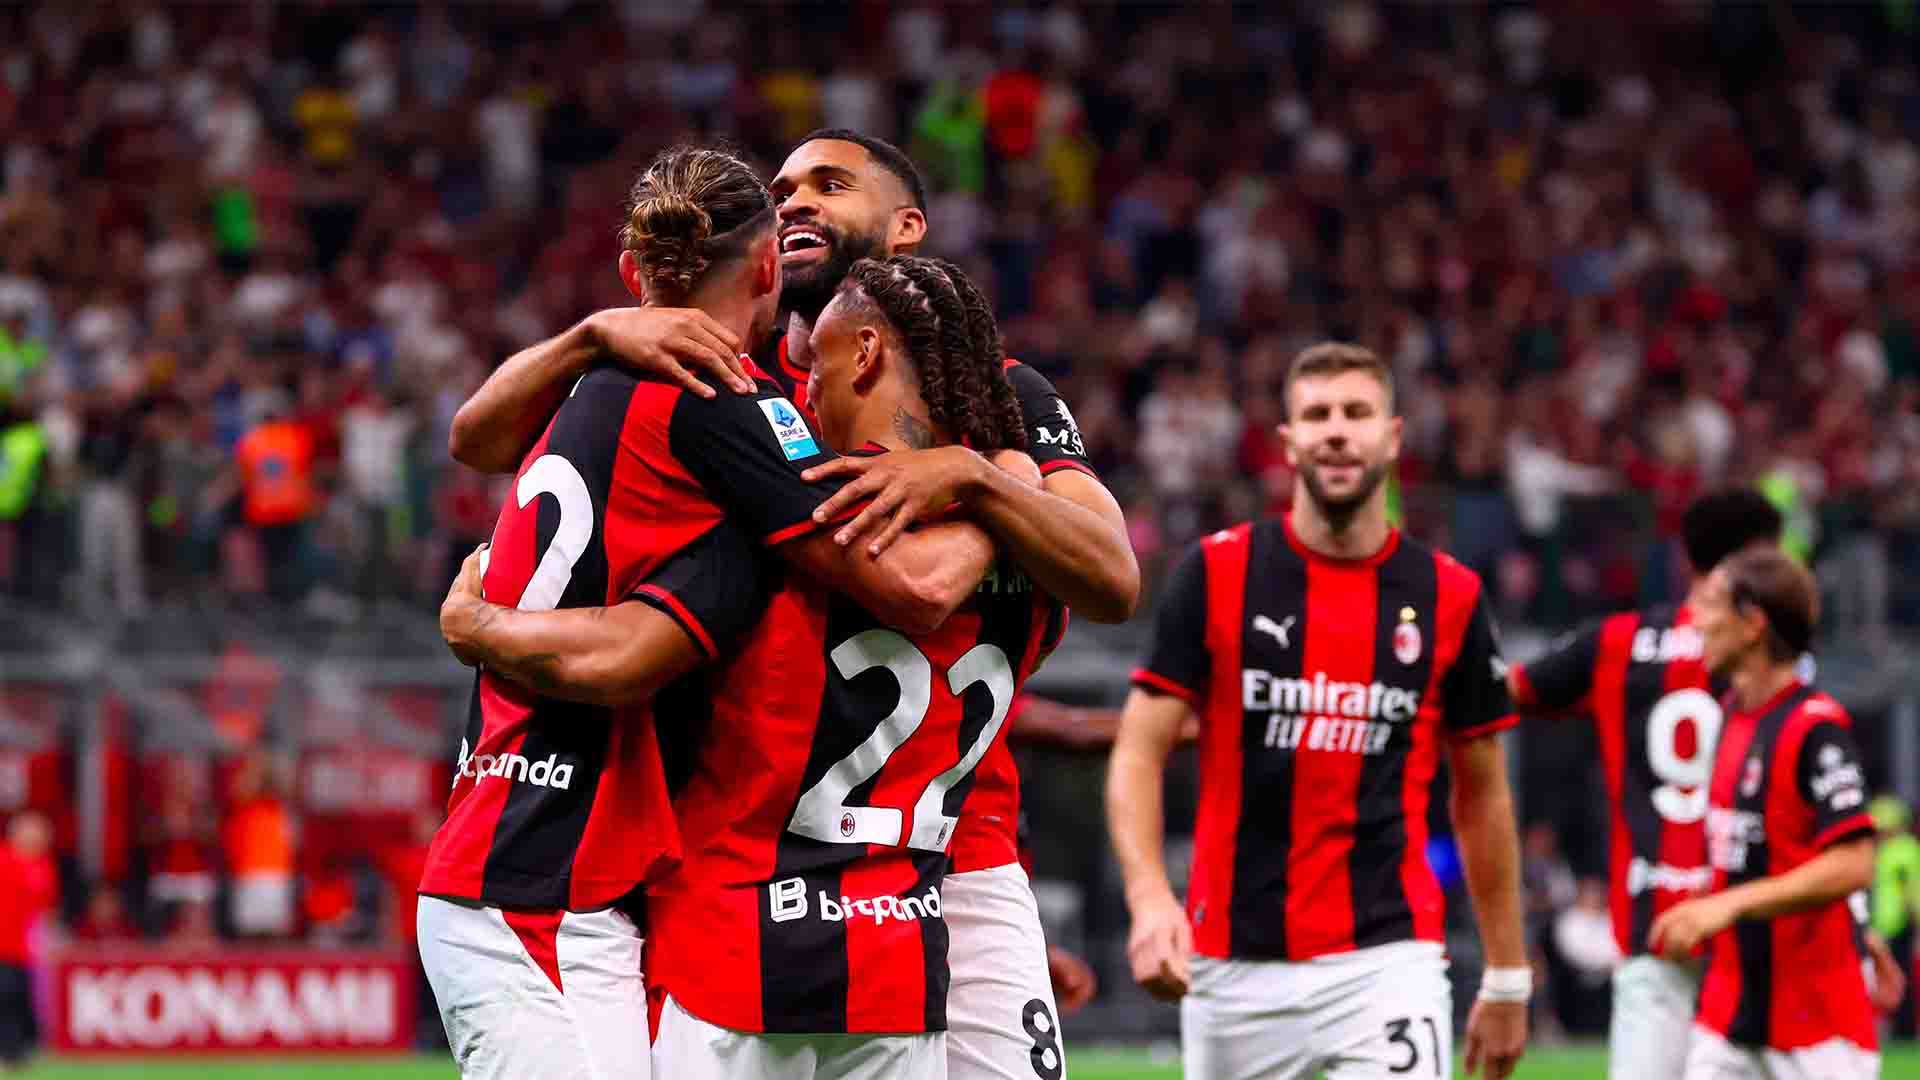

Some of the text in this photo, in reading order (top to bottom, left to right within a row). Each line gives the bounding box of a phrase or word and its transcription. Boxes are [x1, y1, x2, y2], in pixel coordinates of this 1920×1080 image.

[780, 428, 799, 438] SERIE
[1036, 426, 1087, 457] MS
[1242, 669, 1420, 722] Emirates
[787, 629, 1014, 852] 22
[1264, 714, 1392, 755] FLY BETTER
[1646, 688, 1724, 824] 9
[819, 886, 943, 925] bitpand
[71, 968, 396, 1046] KONAMI
[1022, 998, 1062, 1080] 8
[1385, 1017, 1441, 1076] 31
